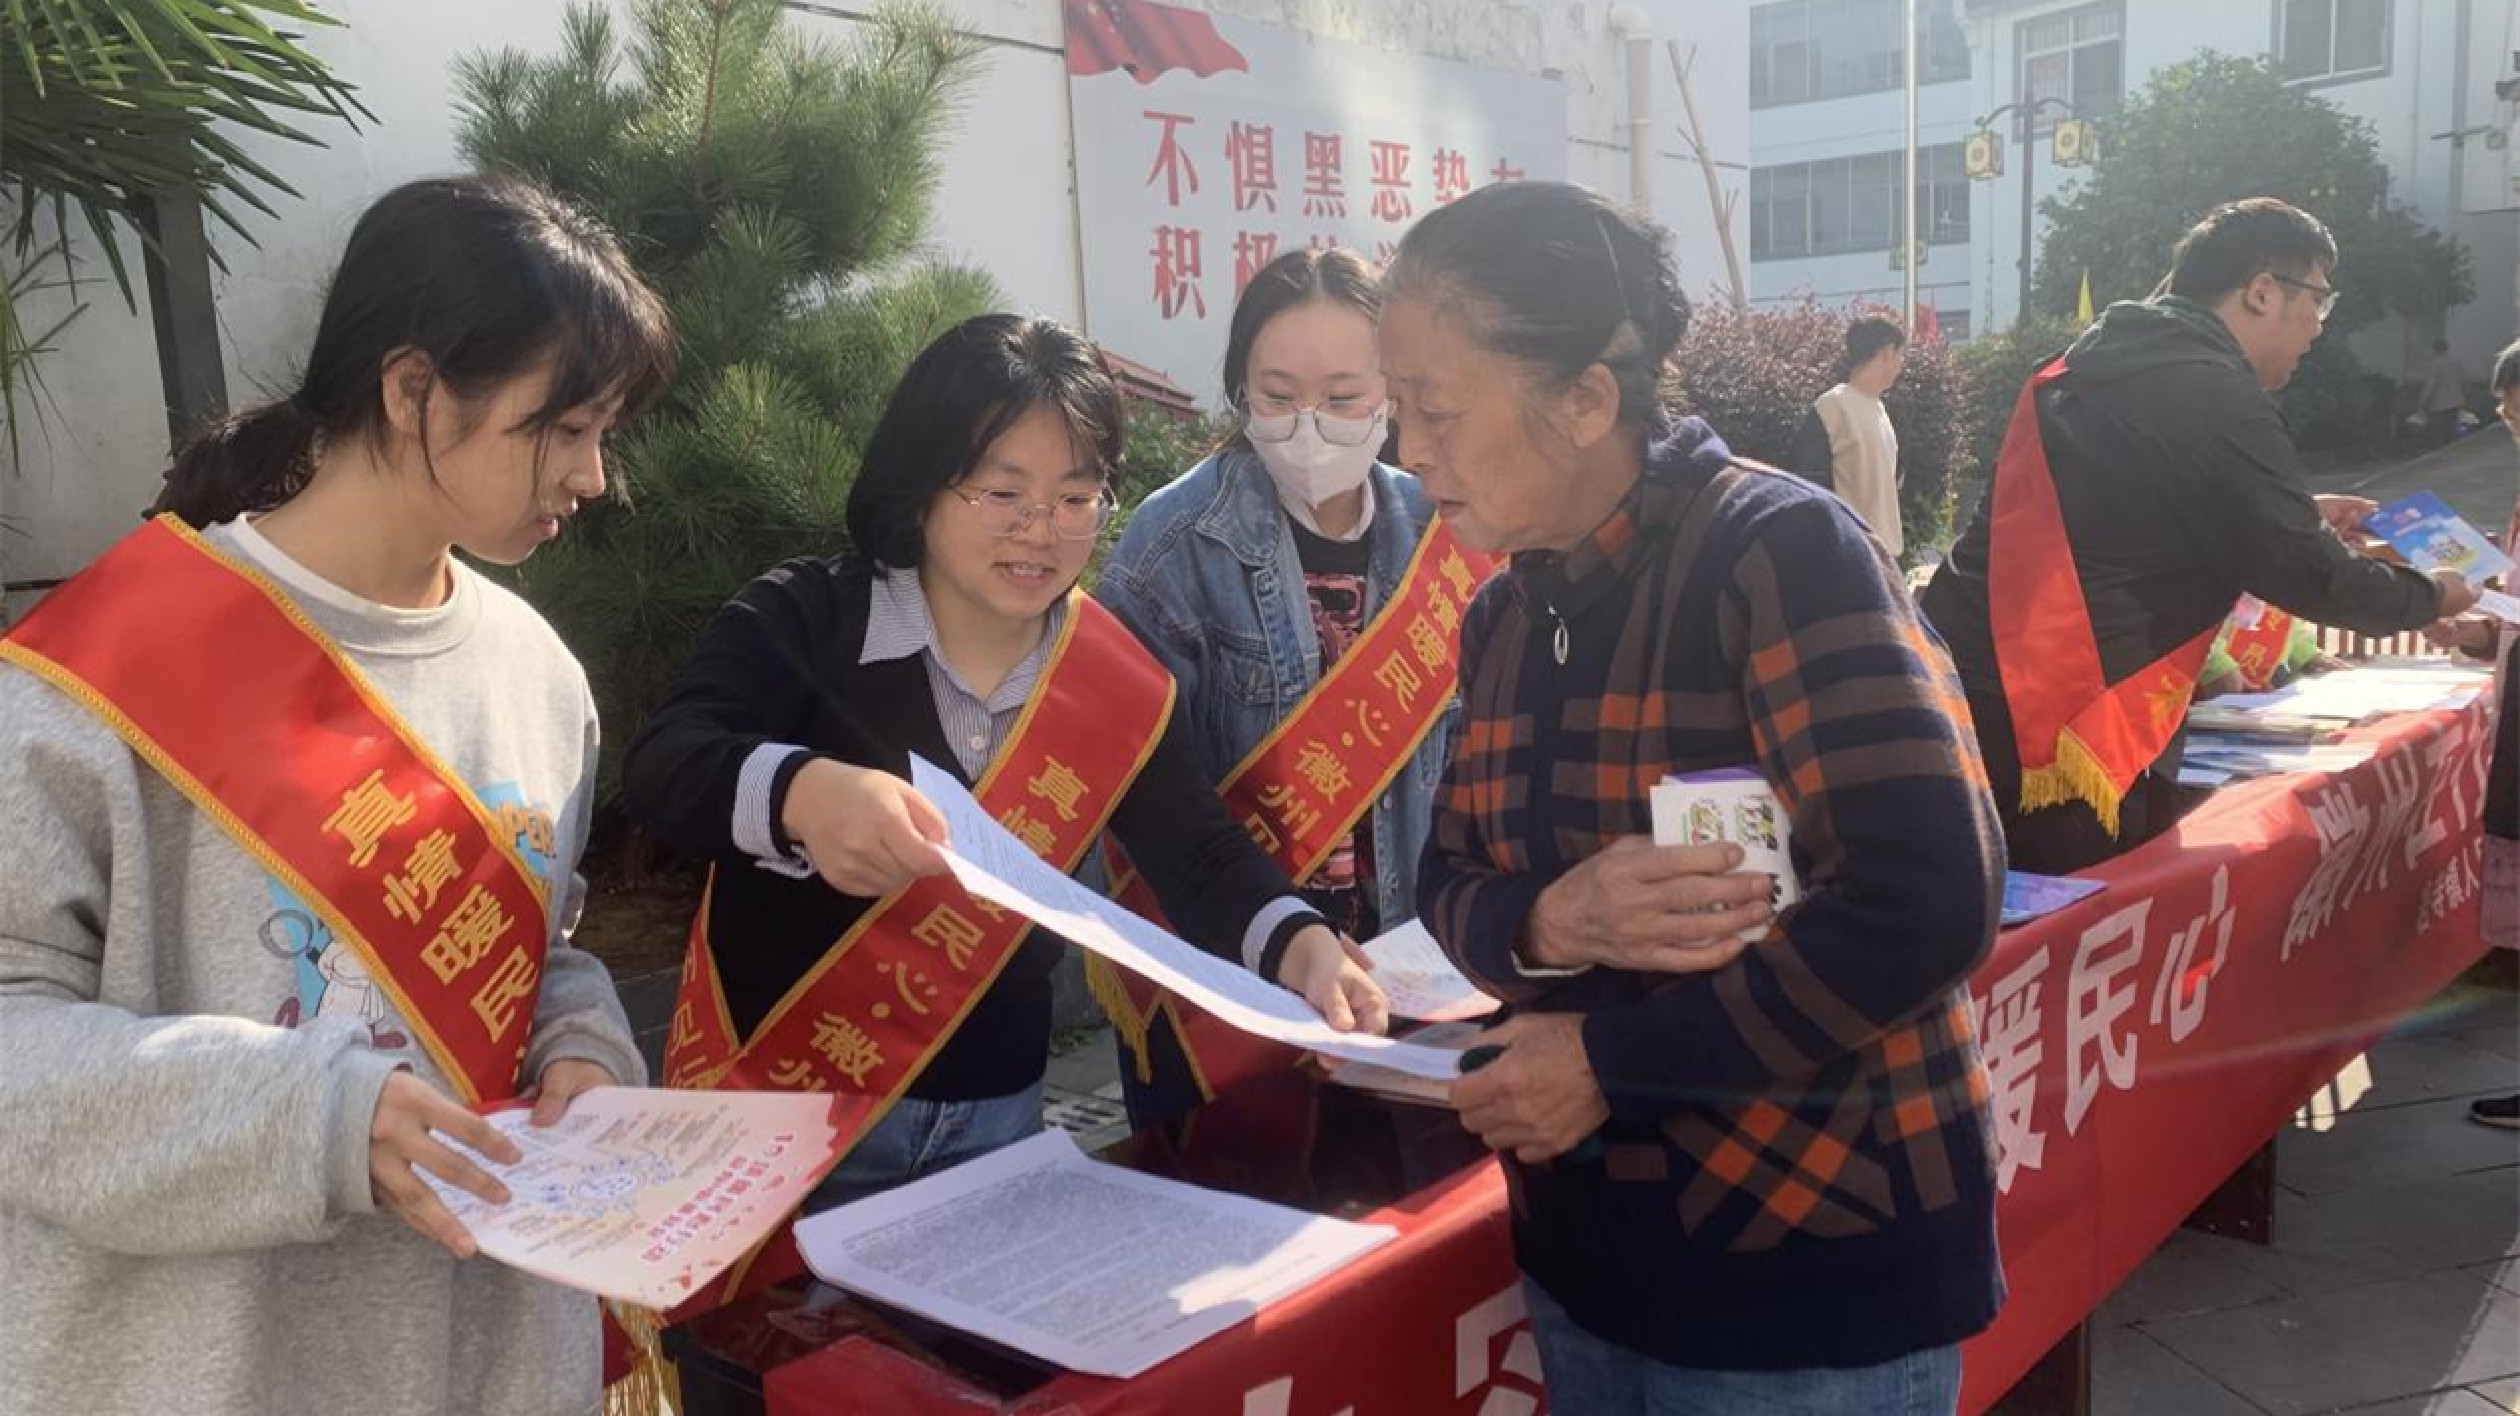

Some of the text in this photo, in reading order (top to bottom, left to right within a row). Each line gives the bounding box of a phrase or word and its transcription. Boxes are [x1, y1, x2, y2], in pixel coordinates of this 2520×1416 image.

[1149, 225, 1397, 321] 积极
[321, 769, 538, 1082] 真情暖民
